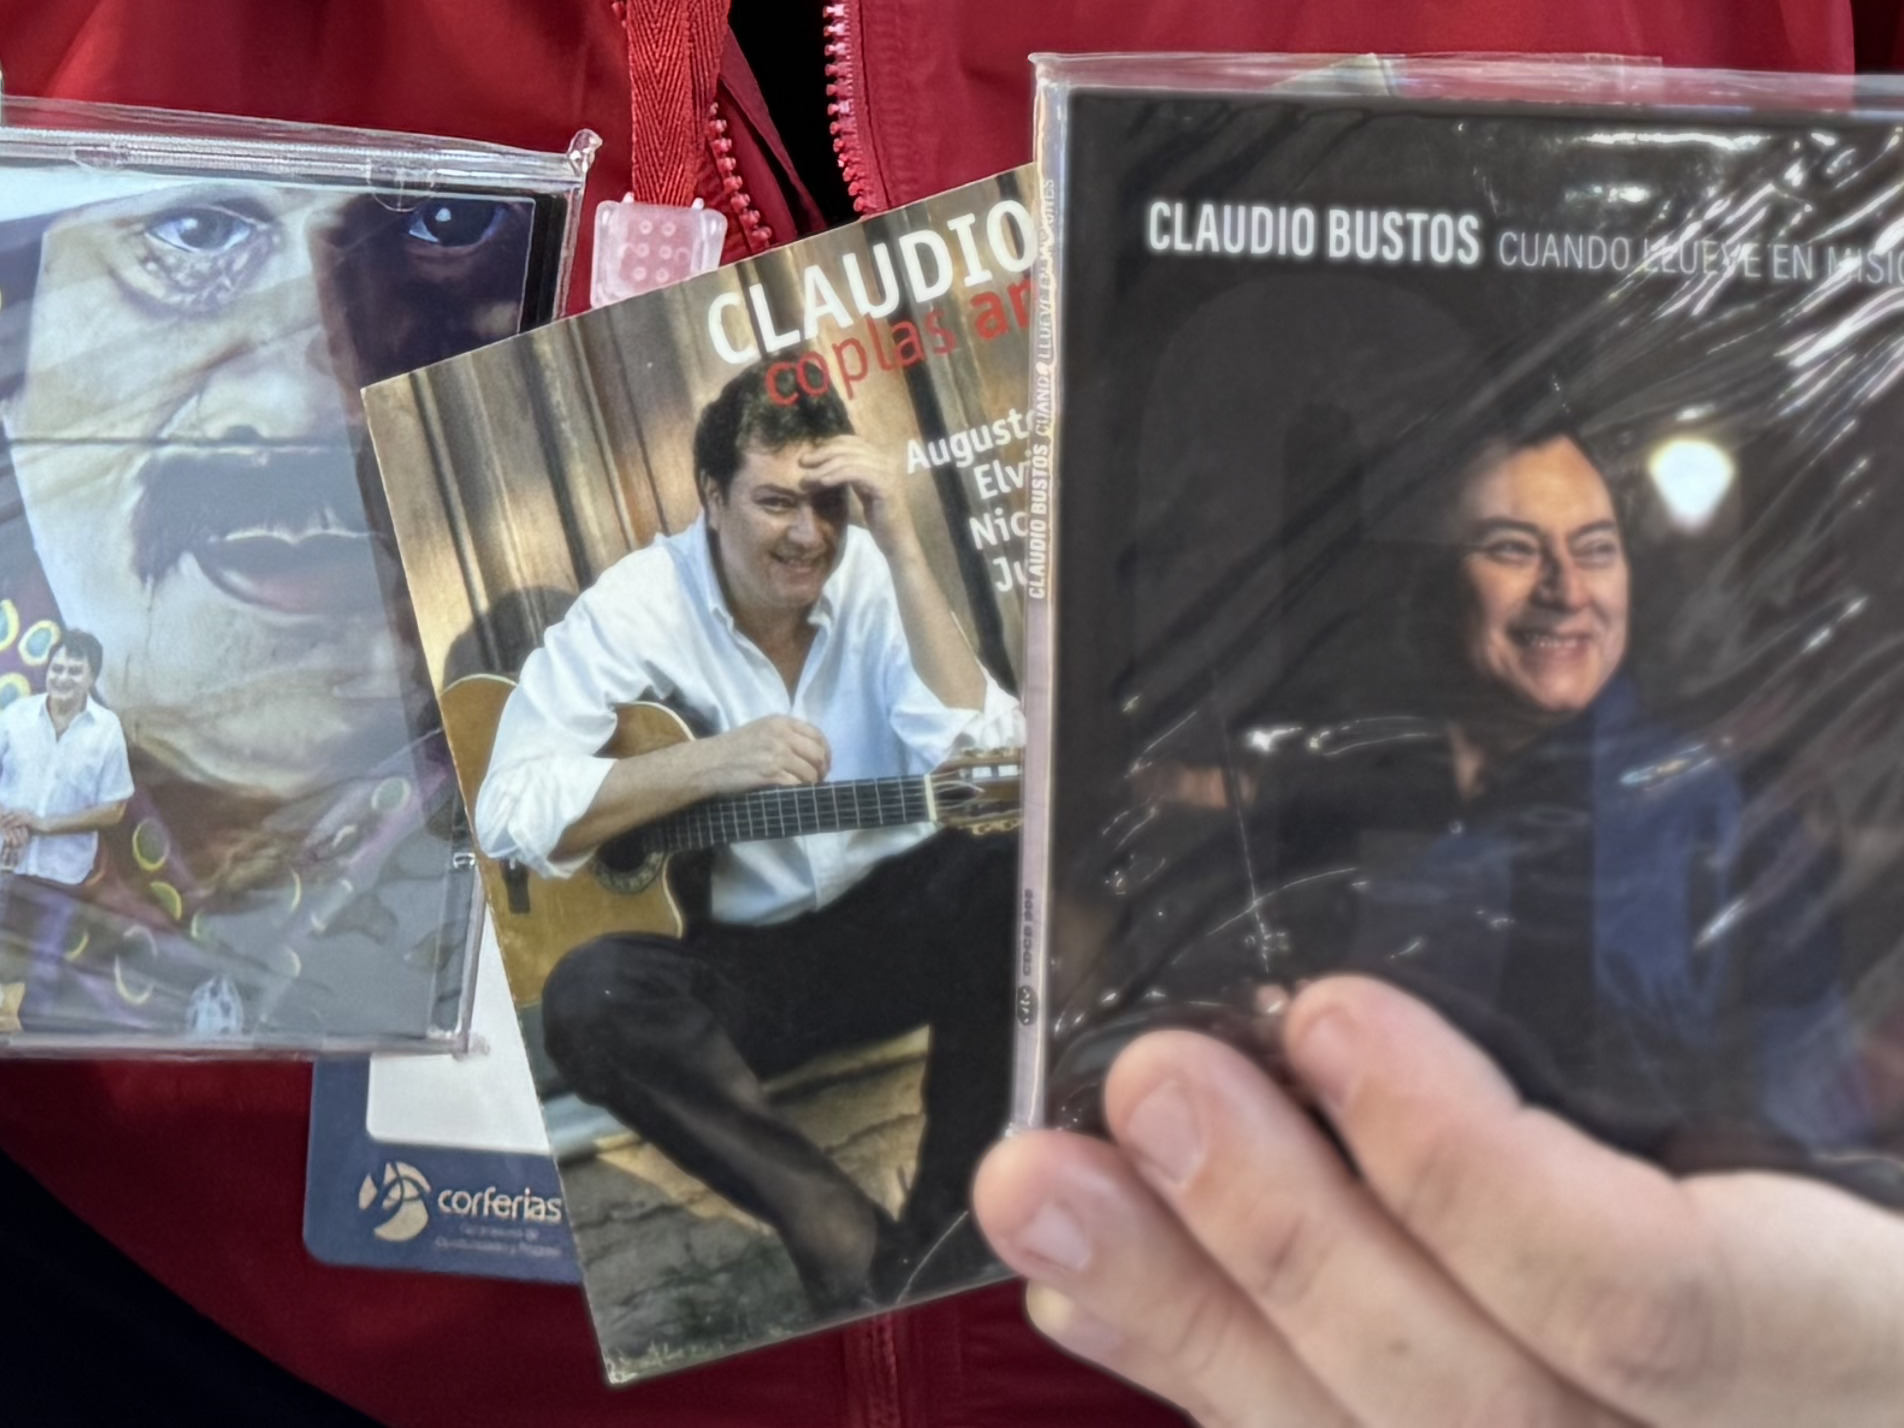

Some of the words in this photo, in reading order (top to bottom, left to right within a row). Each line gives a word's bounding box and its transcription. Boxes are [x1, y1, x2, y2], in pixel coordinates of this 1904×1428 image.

[1148, 200, 1316, 258] CLAUDIO
[1328, 208, 1481, 266] BUSTOS
[1497, 230, 1631, 273] CUANDO
[1644, 236, 1764, 280] LLUEVE
[1772, 243, 1816, 281] EN
[706, 198, 1039, 367] CLAUDIO
[764, 309, 957, 406] coplas
[1030, 444, 1048, 515] BUSTOS
[1028, 518, 1046, 600] CLAUDIO
[437, 1186, 562, 1223] corferias
